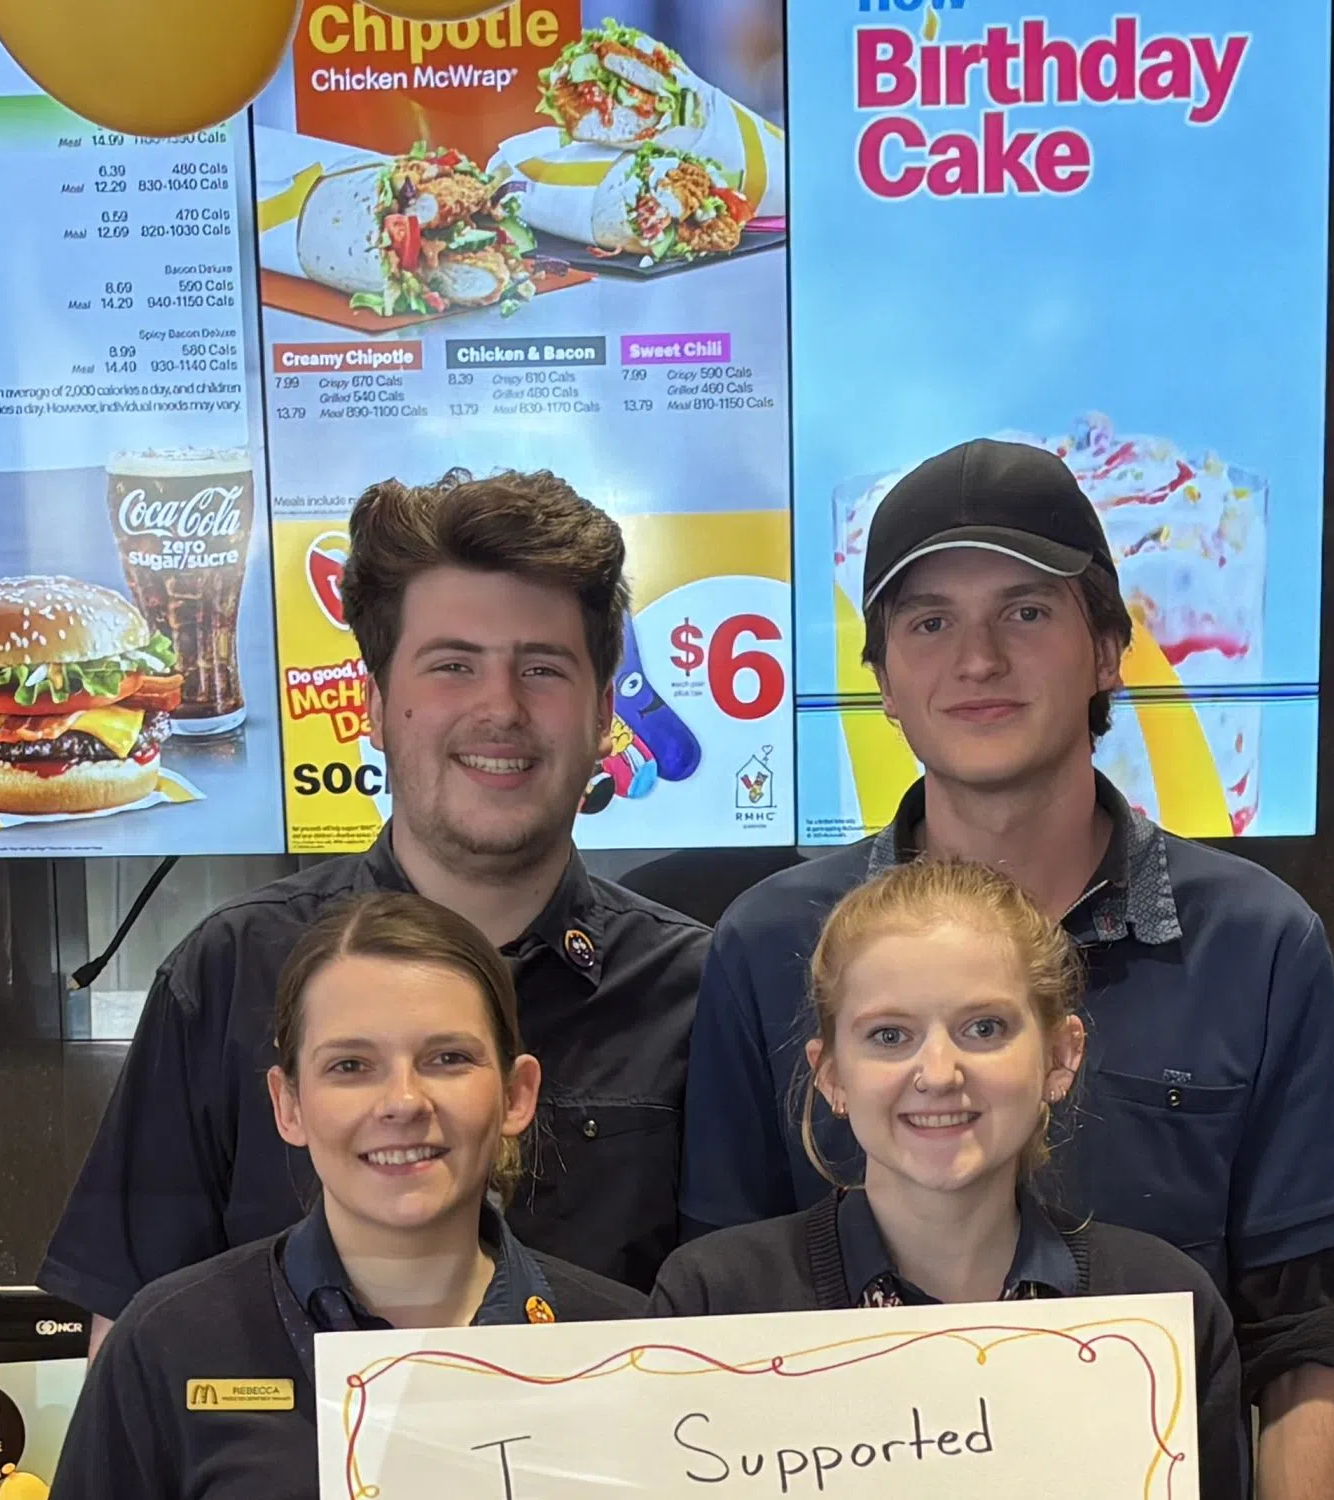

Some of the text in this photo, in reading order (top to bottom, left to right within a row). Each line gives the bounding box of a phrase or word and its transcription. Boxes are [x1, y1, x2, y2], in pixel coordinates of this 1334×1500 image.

[308, 3, 559, 64] Chipotle
[857, 17, 1248, 123] Birthday
[311, 66, 408, 92] Chicken
[858, 112, 1090, 197] Cake
[199, 163, 228, 174] Cals
[201, 179, 229, 189] Cals
[175, 210, 199, 220] 470
[202, 209, 230, 220] Cals
[203, 225, 231, 235] Cals
[205, 280, 234, 291] Cals
[206, 295, 235, 306] Cals
[208, 344, 237, 355] Cals
[457, 345, 595, 363] Chicken & Bacon
[629, 341, 722, 358] Sweet Chili
[282, 349, 414, 368] Creamy Chipotle
[209, 359, 238, 371] Cals
[549, 371, 576, 383] Cals
[725, 367, 752, 378] Cals
[376, 375, 403, 387] Cals
[553, 387, 579, 398] Cals
[726, 382, 753, 393] Cals
[378, 391, 405, 402] Cals
[574, 401, 600, 412] Cals
[624, 400, 653, 411] 13.79
[747, 397, 774, 408] Cals
[277, 407, 306, 419] 13.79
[402, 405, 428, 416] Cals
[308, 495, 345, 506] include
[119, 485, 243, 537] Coca-Cola
[163, 540, 206, 554] zero
[129, 549, 239, 571] sugar/sucre
[288, 670, 310, 685] Do
[58, 1322, 83, 1333] NCR
[674, 1398, 994, 1494] Supported
